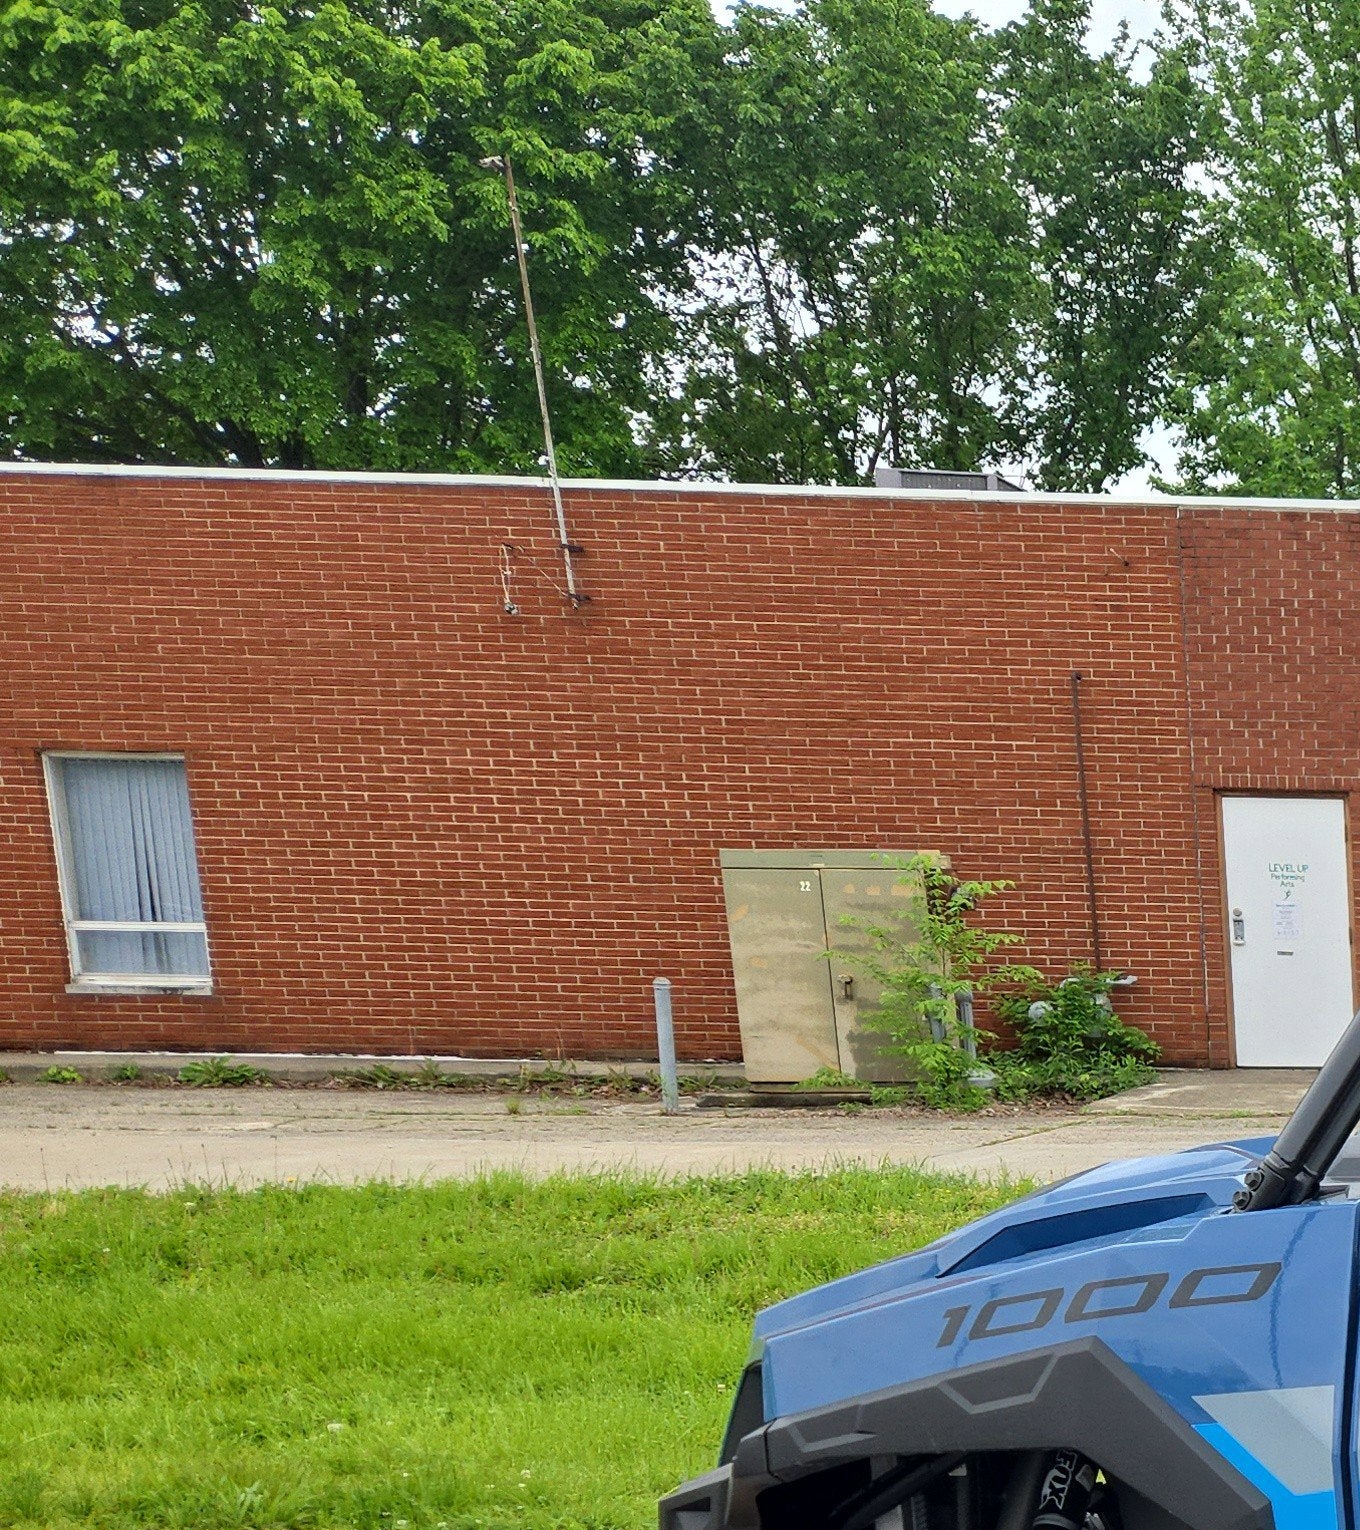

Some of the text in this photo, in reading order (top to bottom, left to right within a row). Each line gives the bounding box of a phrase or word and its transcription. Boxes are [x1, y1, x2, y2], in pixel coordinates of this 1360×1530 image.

[1268, 862, 1309, 873] LEVEL UP
[799, 880, 811, 892] 22
[936, 1261, 1282, 1348] 1000
[1038, 1450, 1078, 1510] FOX
